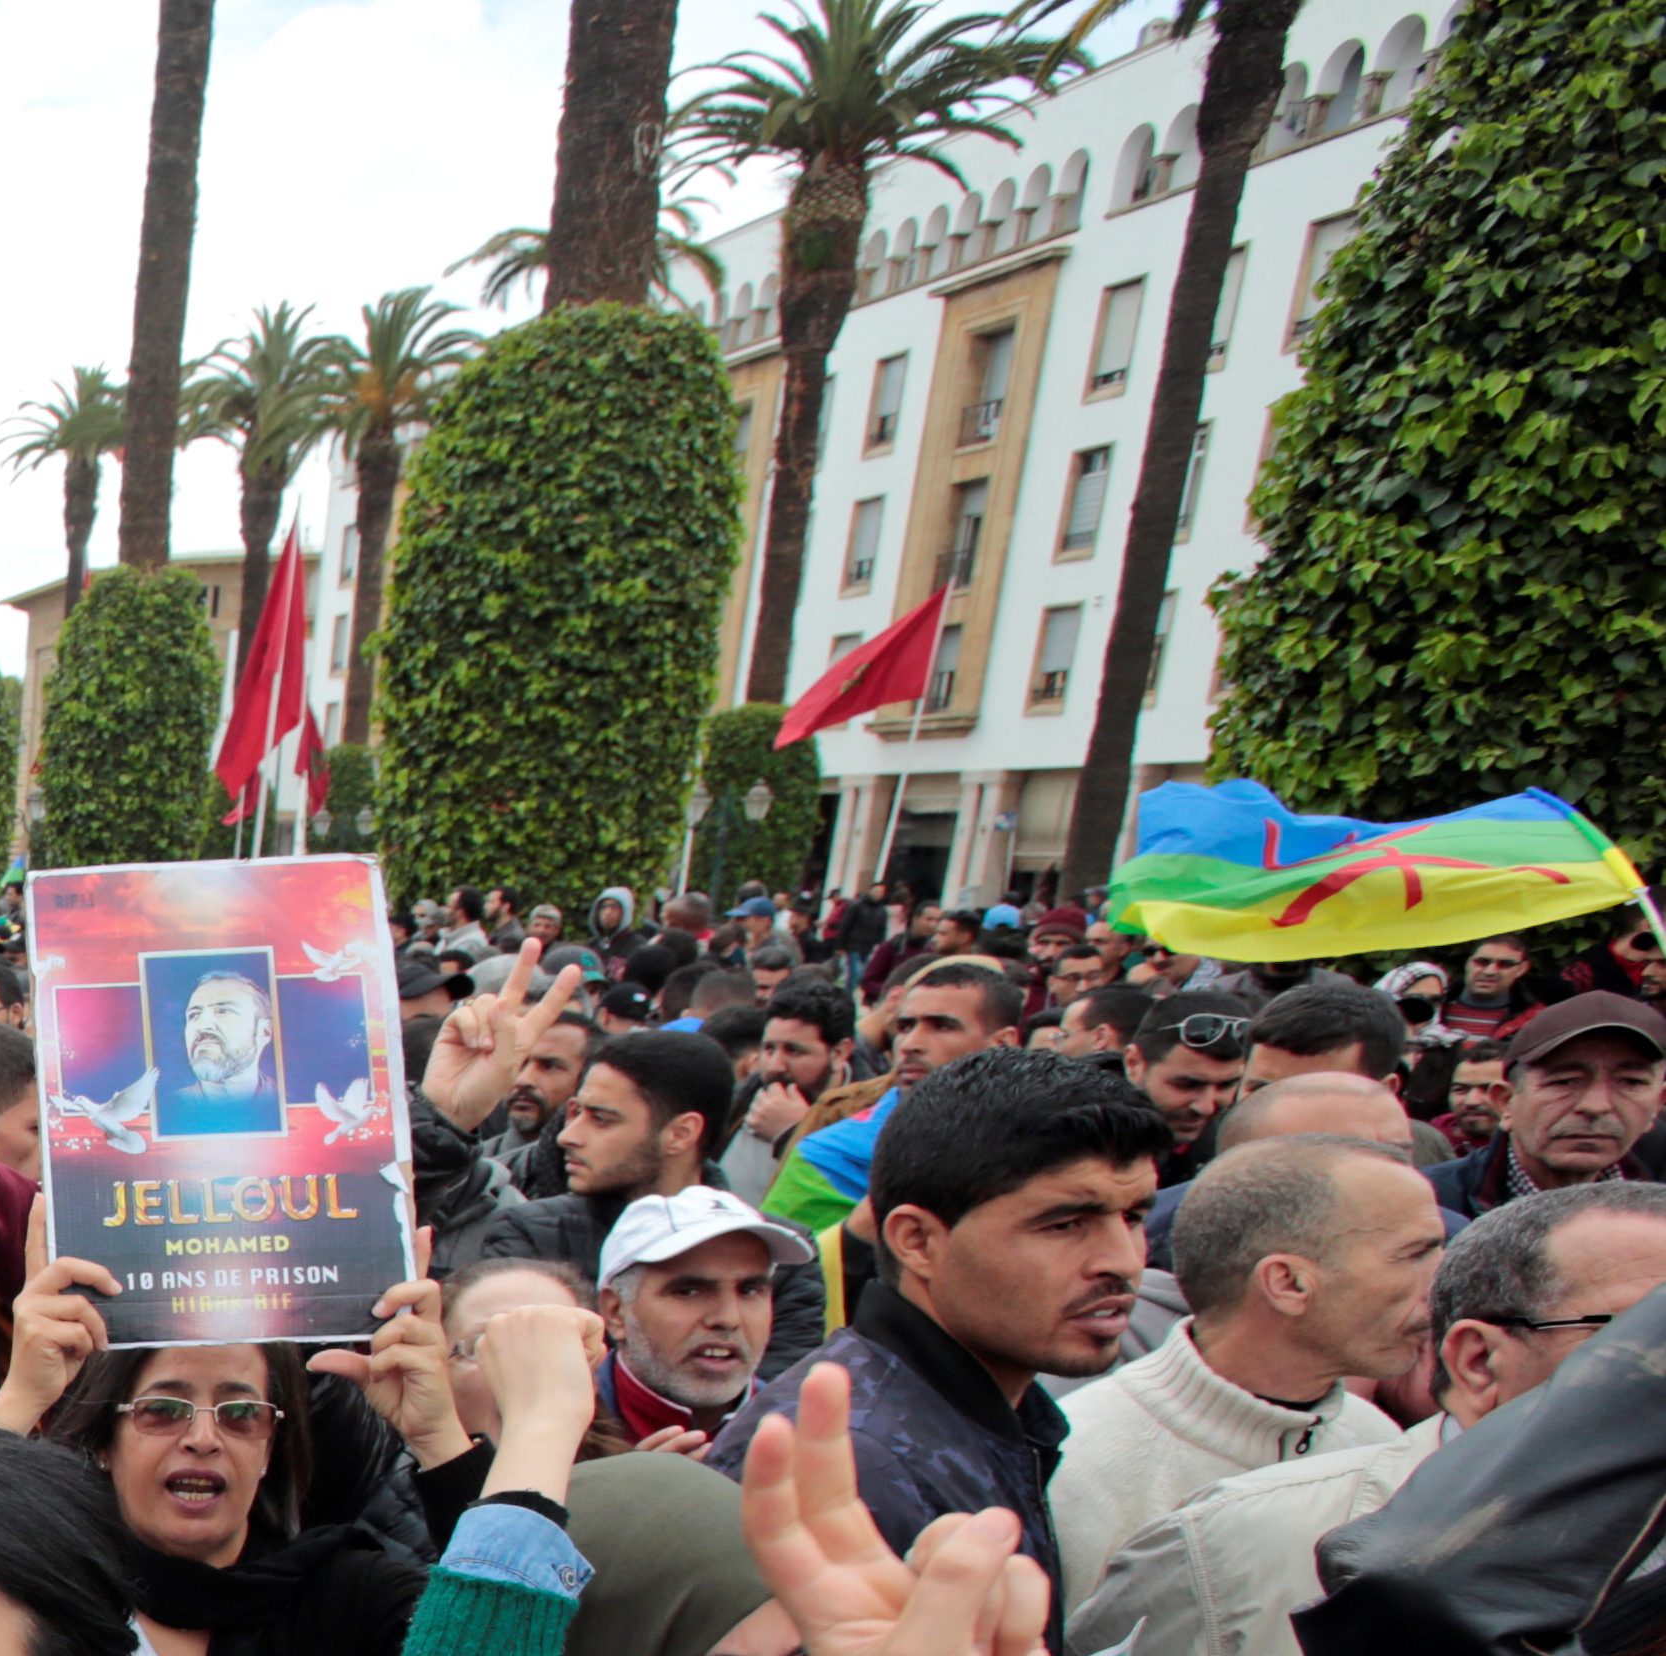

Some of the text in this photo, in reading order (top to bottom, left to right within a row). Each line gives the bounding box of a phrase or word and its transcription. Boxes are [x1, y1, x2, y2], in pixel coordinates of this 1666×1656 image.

[103, 1173, 358, 1227] JELLOUL
[165, 1235, 291, 1256] MOHAMED
[126, 1265, 340, 1291] 10 ANS DE PRISON
